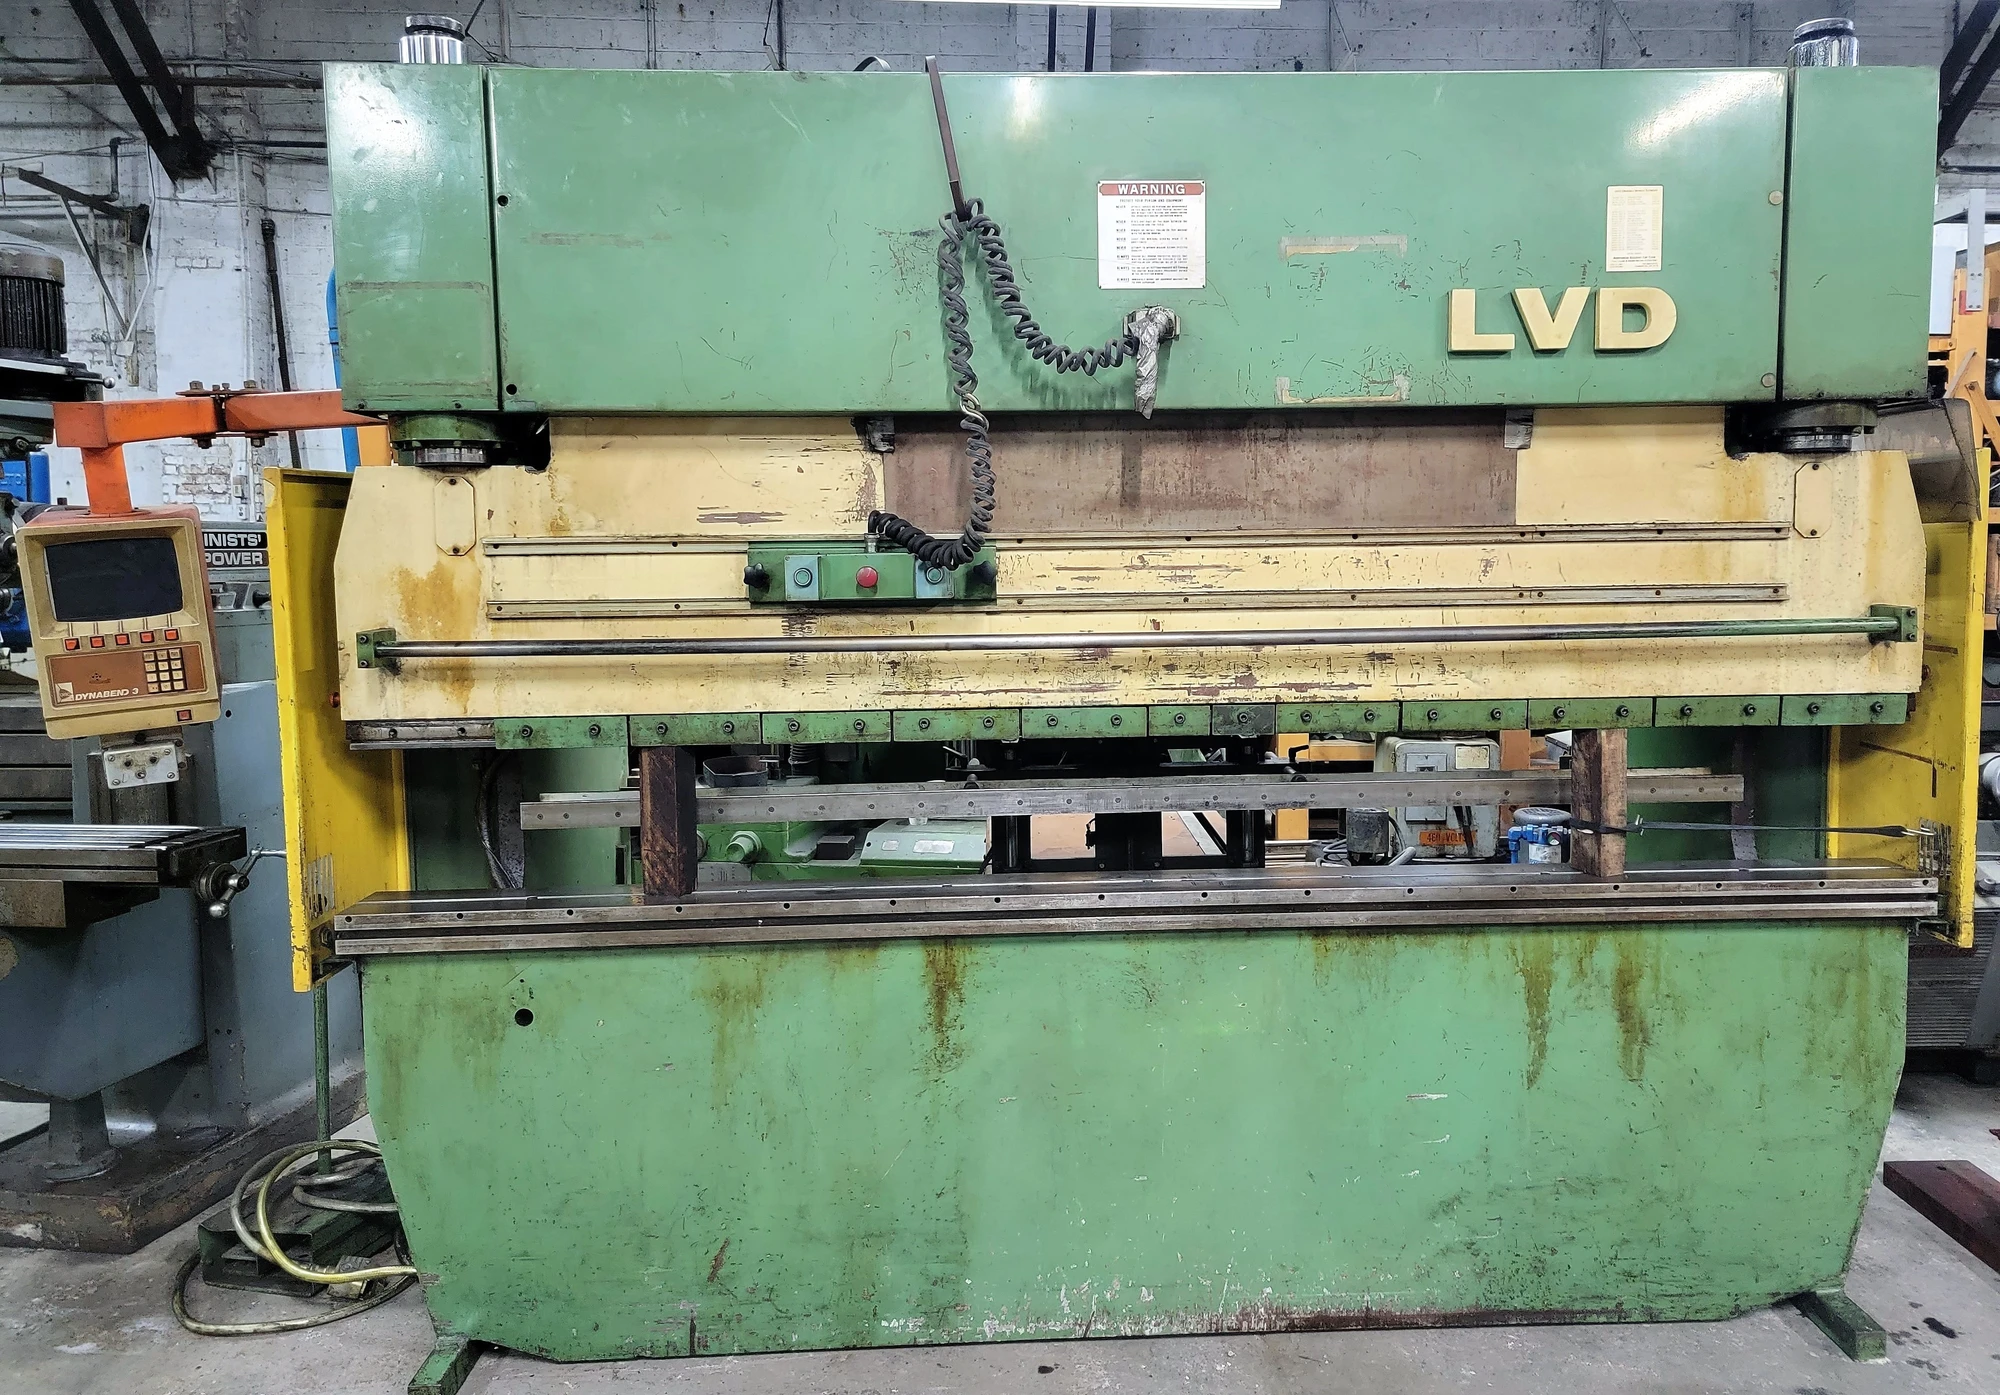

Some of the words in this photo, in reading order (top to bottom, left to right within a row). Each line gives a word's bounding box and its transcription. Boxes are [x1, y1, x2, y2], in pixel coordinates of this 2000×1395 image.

[1117, 184, 1186, 195] WARNING
[1449, 286, 1677, 350] LVD
[205, 552, 263, 566] POWER
[75, 689, 130, 701] DYNABEND
[132, 687, 139, 695] 3
